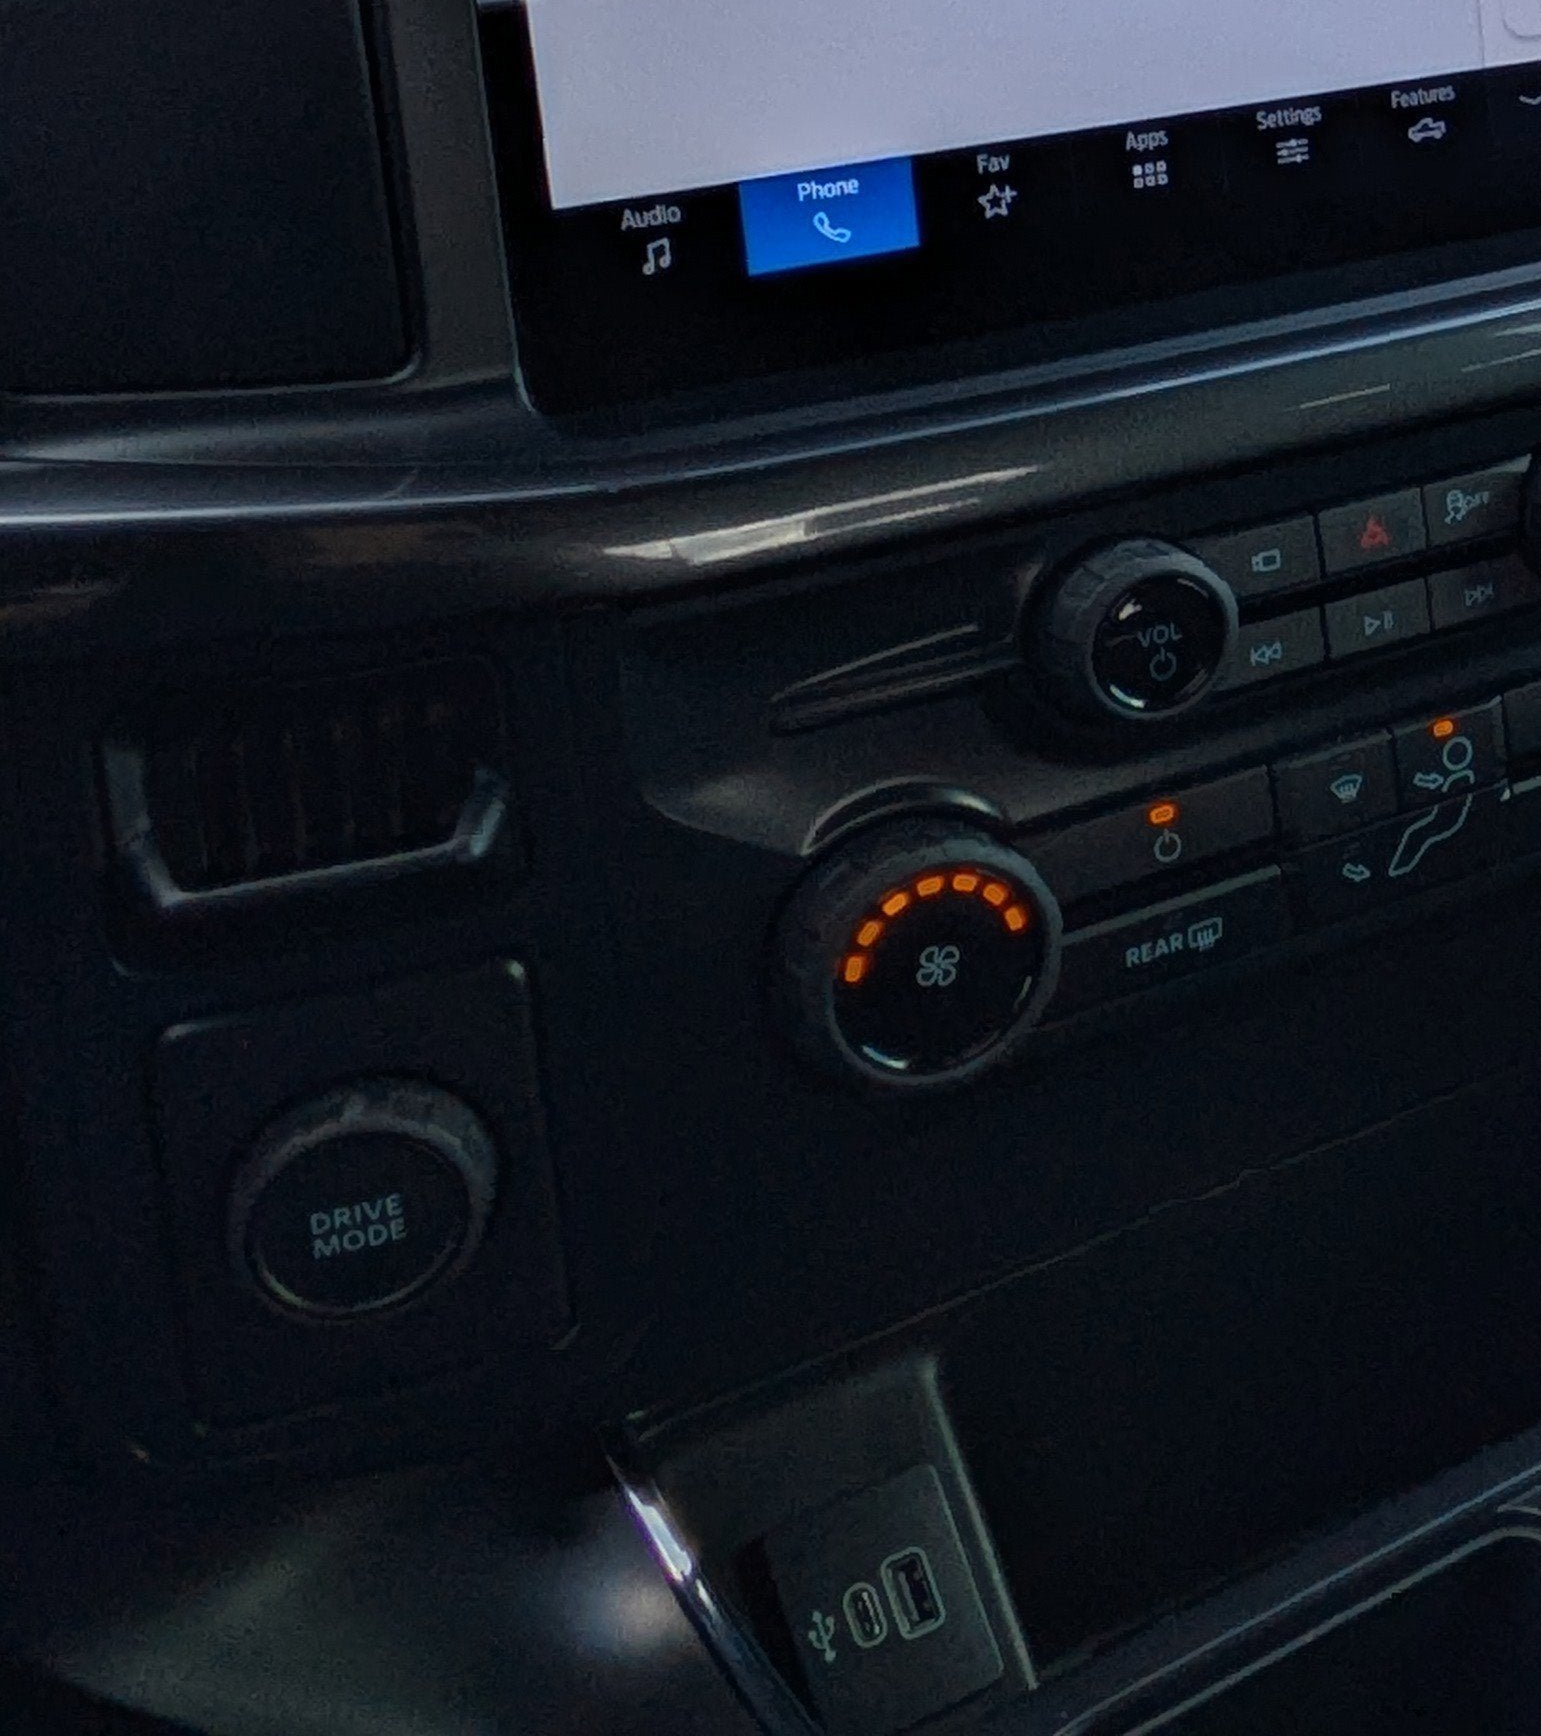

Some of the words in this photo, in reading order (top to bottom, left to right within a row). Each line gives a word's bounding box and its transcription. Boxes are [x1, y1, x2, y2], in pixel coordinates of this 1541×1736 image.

[1391, 85, 1455, 109] Features
[1256, 106, 1322, 131] Settings
[1126, 130, 1169, 151] Apps
[976, 153, 1011, 175] Fav
[797, 179, 859, 201] Phone
[621, 204, 681, 231] Audio
[1136, 621, 1183, 647] VOL
[1126, 932, 1184, 968] REAR
[310, 1192, 403, 1236] DRIVE
[312, 1216, 408, 1260] MODE
